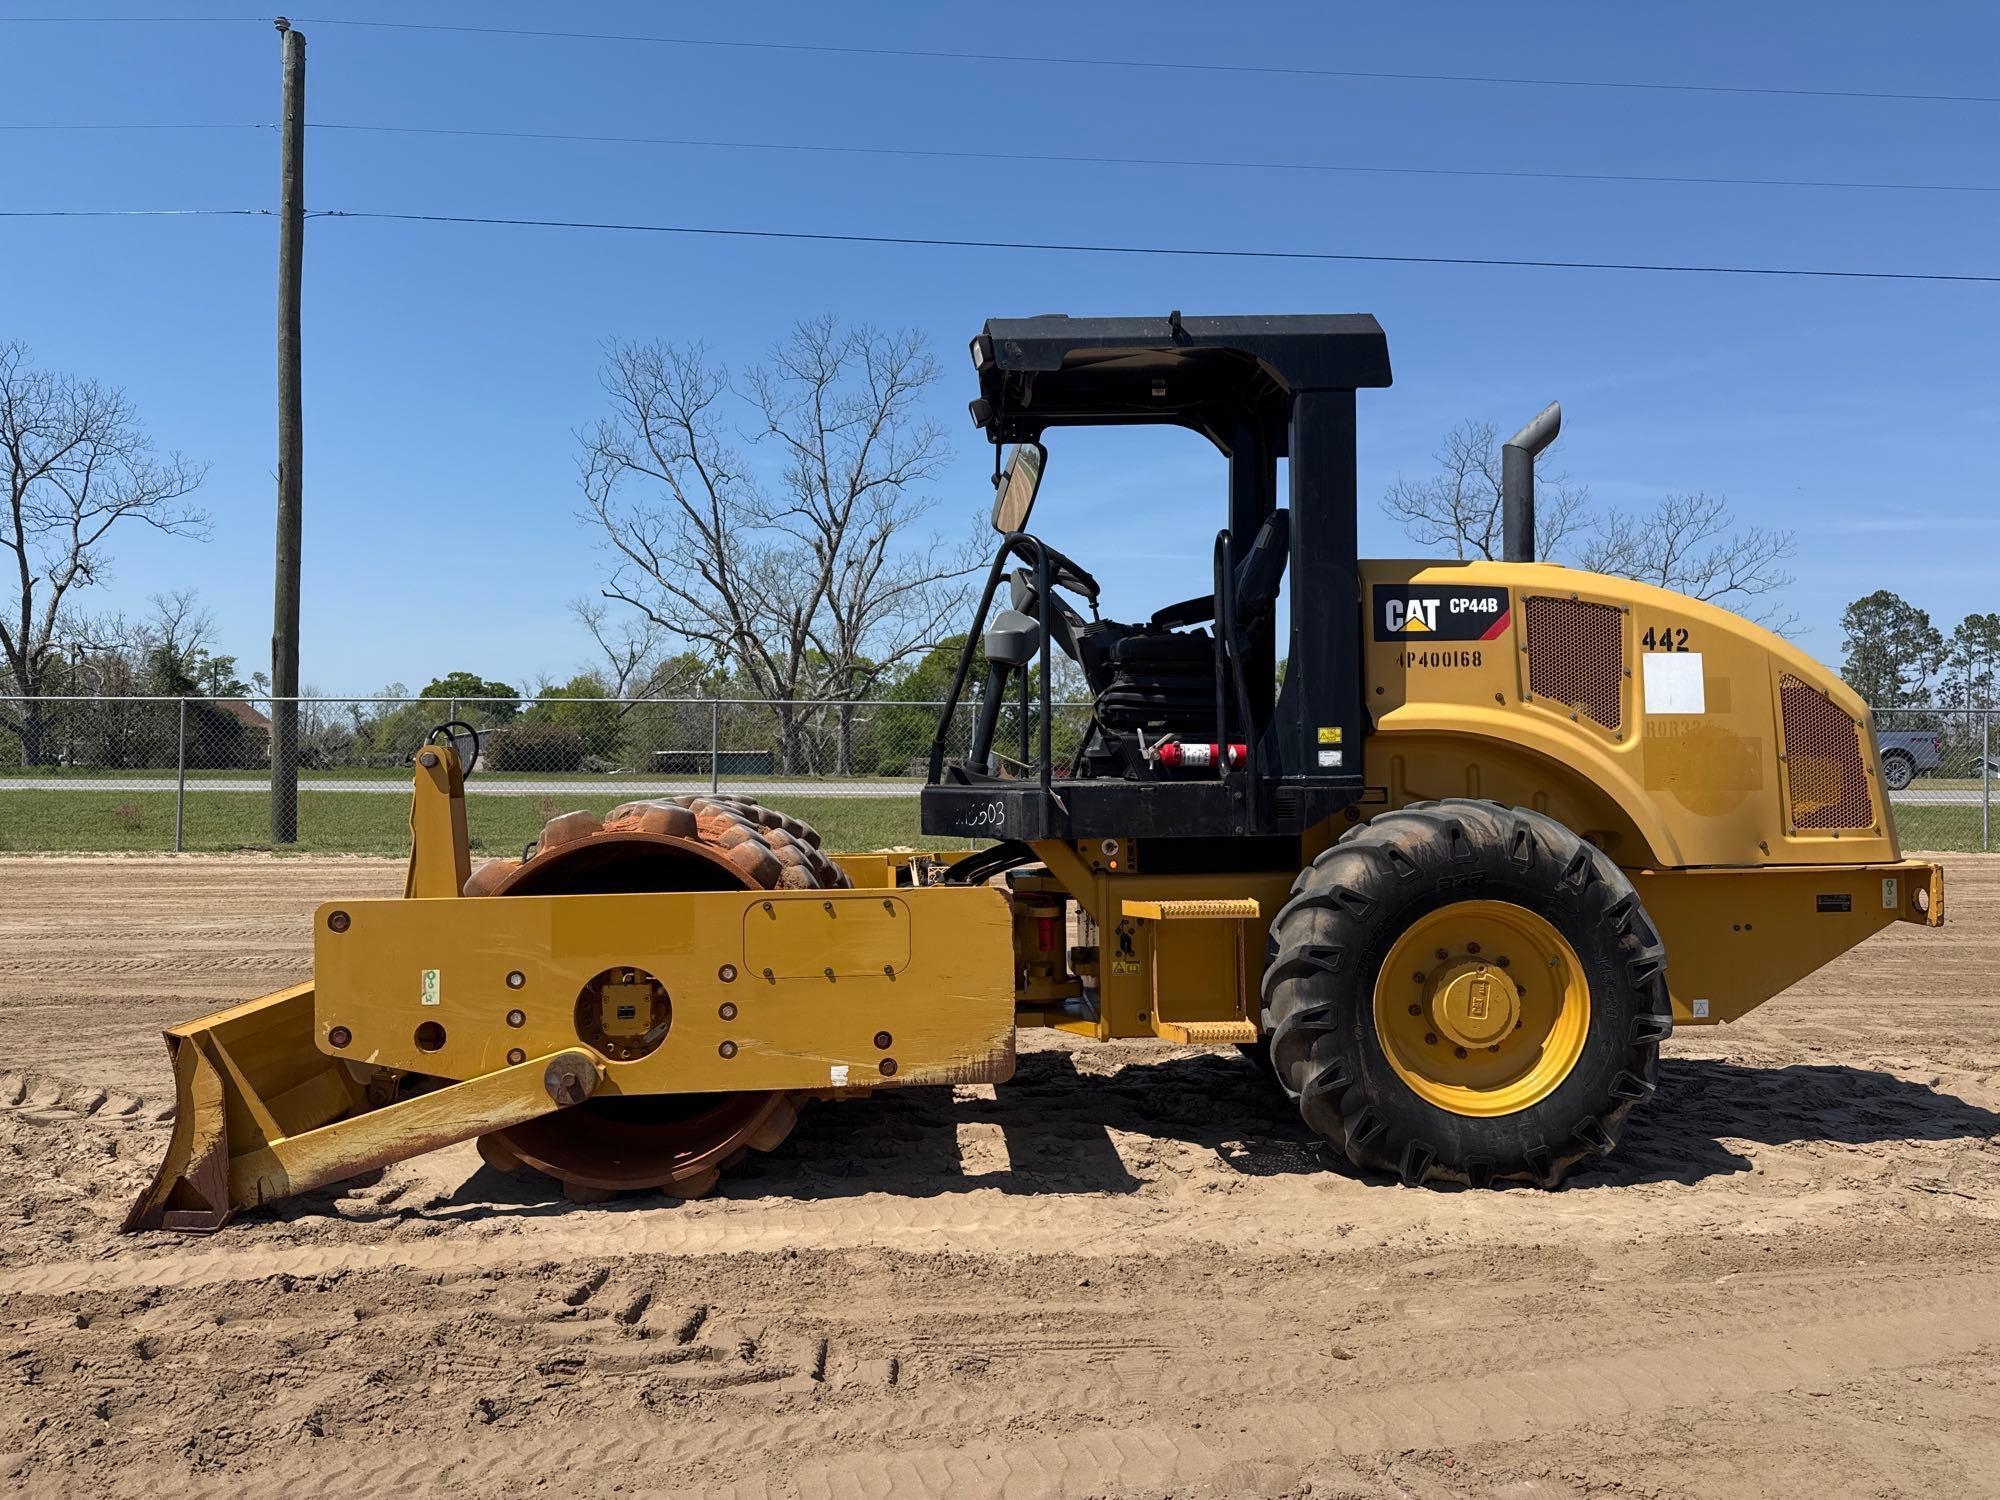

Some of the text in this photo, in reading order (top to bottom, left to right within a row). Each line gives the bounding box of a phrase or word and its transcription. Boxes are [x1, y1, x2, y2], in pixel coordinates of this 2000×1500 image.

[1385, 599, 1440, 632] CAT
[1449, 598, 1498, 613] CP44B
[1642, 626, 1689, 652] 442
